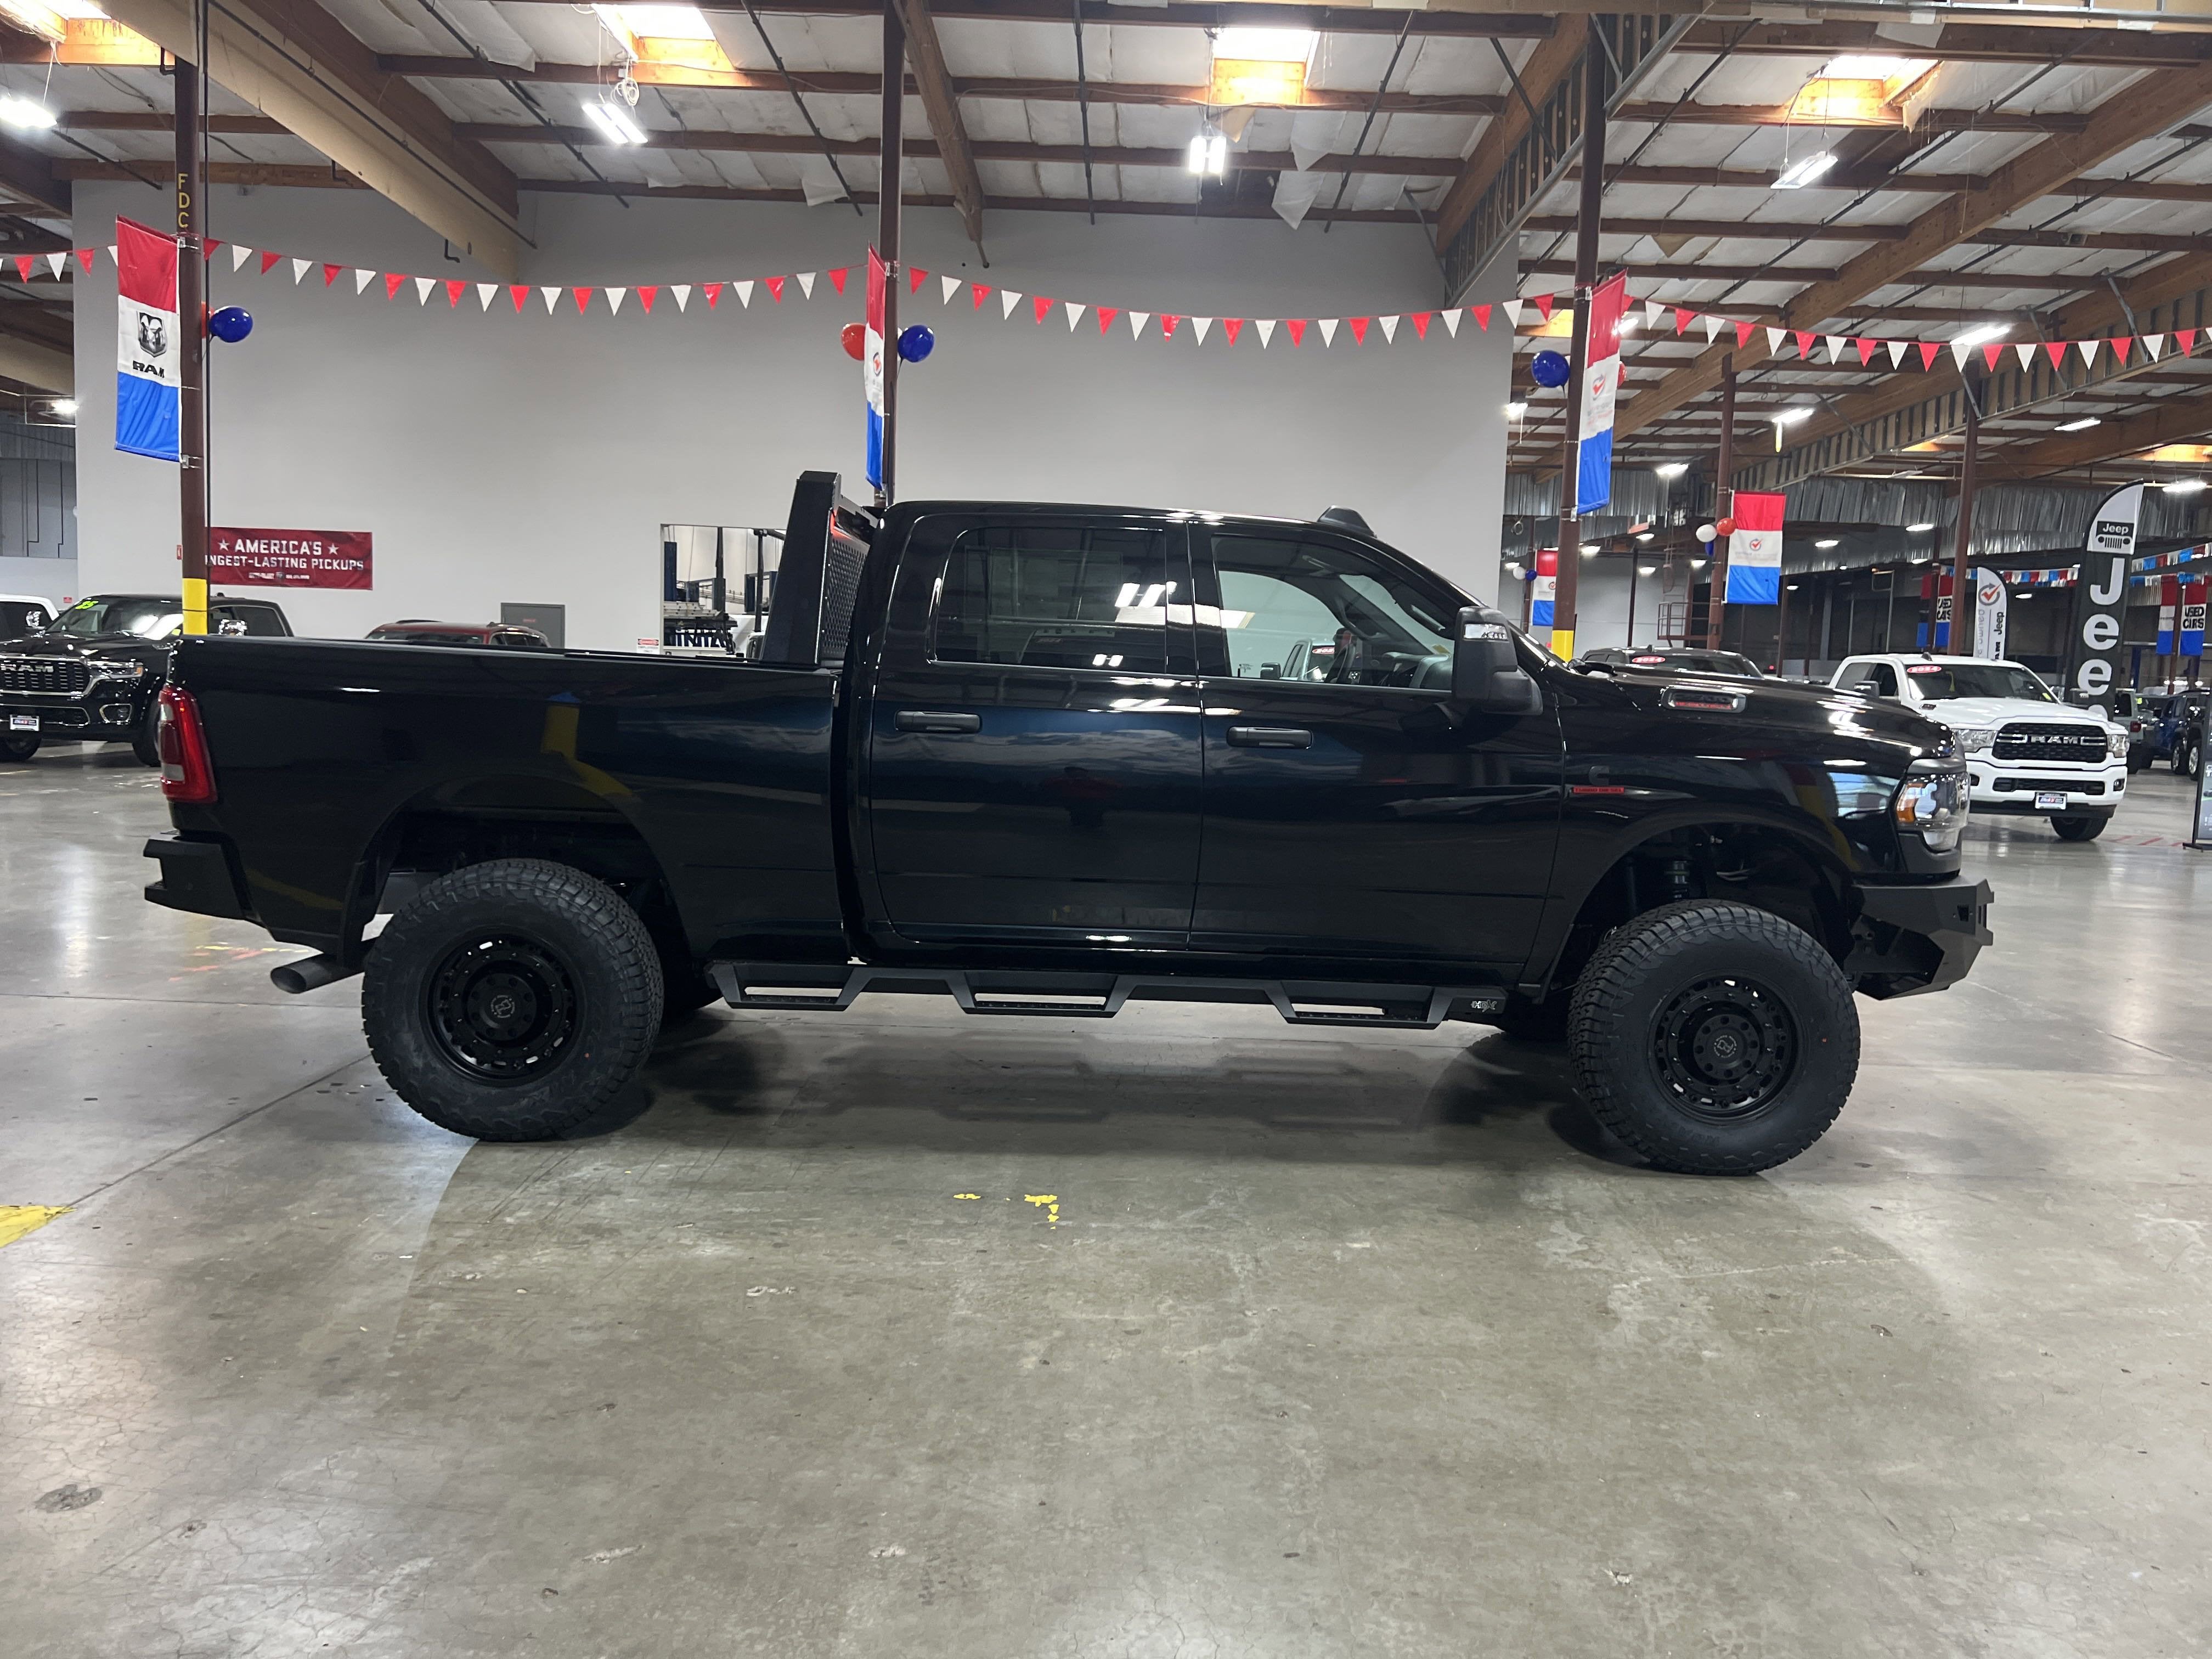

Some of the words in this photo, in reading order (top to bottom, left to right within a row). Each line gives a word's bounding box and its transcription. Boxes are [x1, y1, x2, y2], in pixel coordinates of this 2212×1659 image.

[178, 173, 190, 228] FDC
[2102, 523, 2129, 535] Jeep
[235, 539, 323, 555] AMERICA'S
[205, 555, 307, 568] NGEST-LASTING
[312, 558, 364, 571] PICKUPS
[1994, 612, 2004, 635] Jeep
[1, 663, 54, 672] RAM
[2031, 736, 2078, 744] RAM
